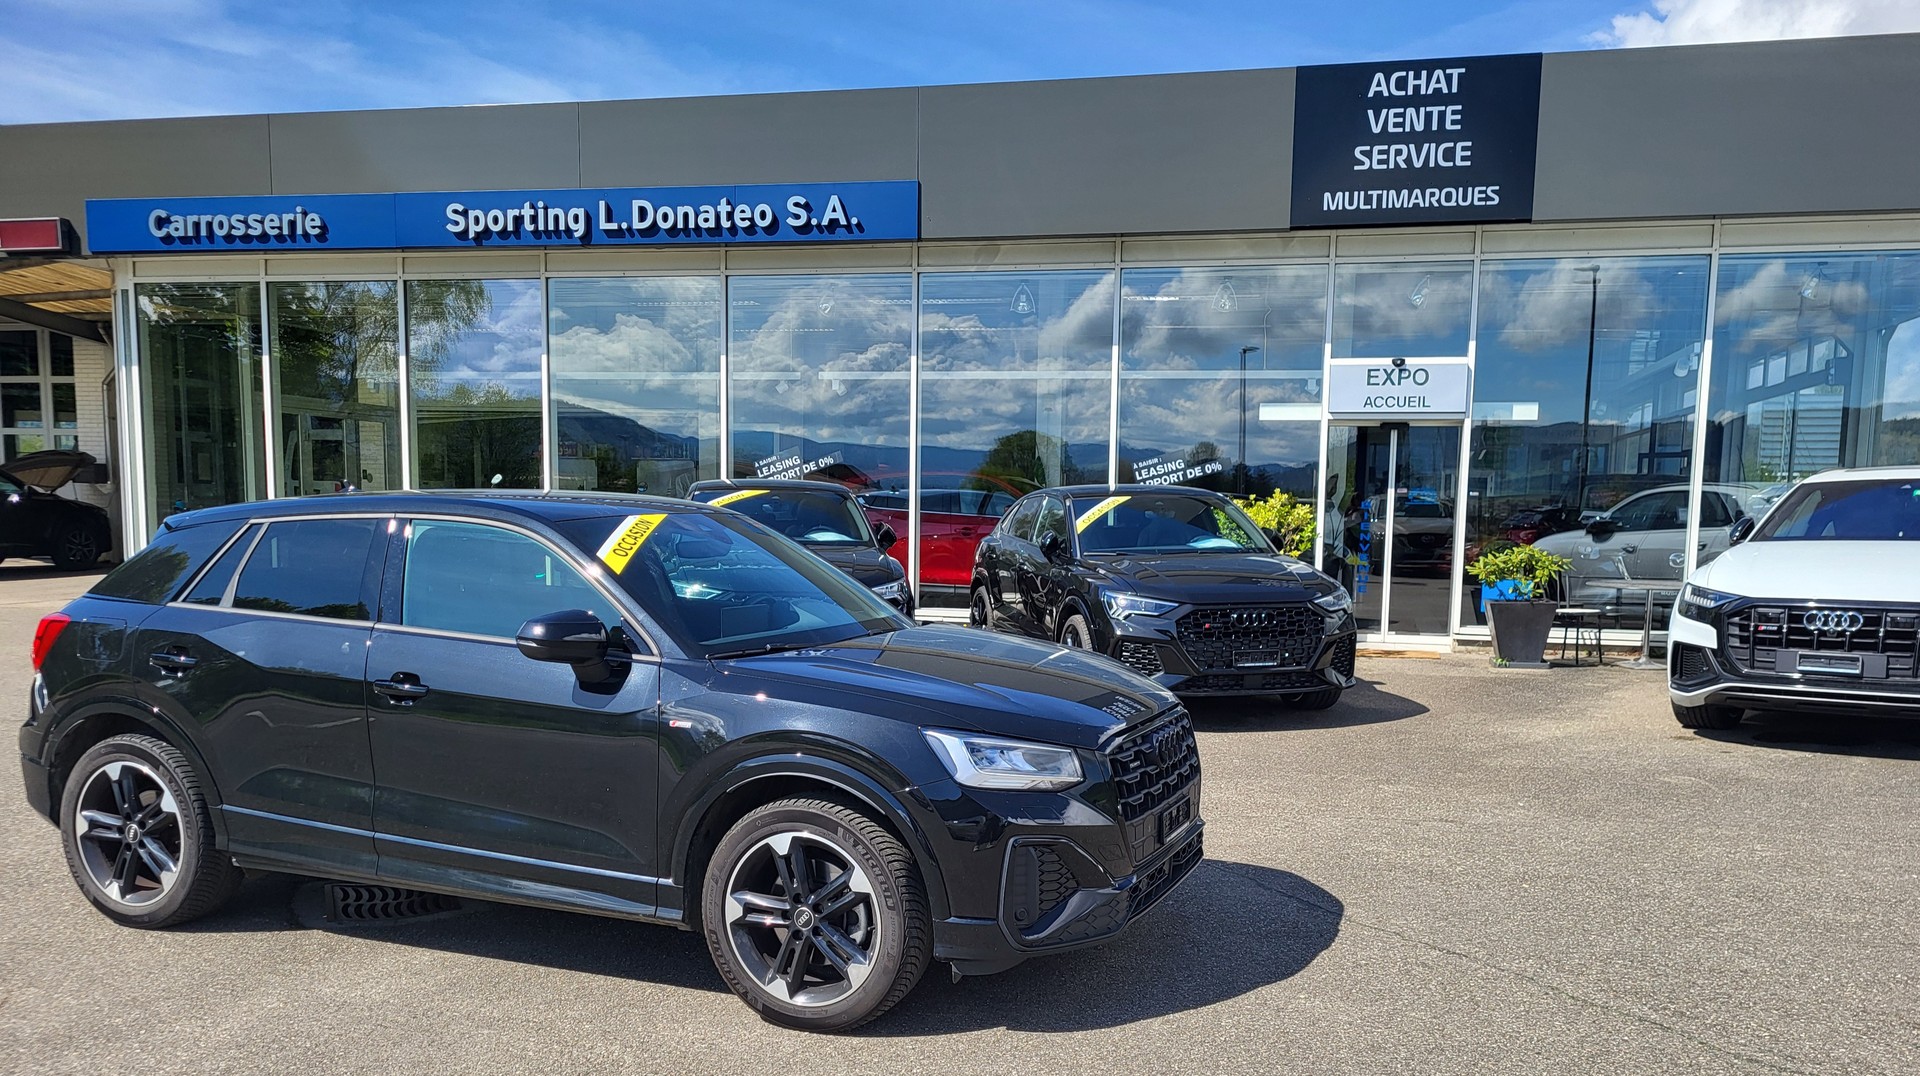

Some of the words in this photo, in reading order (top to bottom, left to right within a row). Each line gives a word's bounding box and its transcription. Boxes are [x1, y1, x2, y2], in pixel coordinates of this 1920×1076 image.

[1367, 68, 1466, 97] ACHAT
[1367, 105, 1462, 133] VENTE
[1353, 141, 1472, 170] SERVICE
[1323, 185, 1500, 211] MULTIMARQUES
[148, 206, 321, 237] Carrosserie
[445, 201, 586, 238] Sporting
[598, 197, 773, 230] L.Donateo
[785, 195, 859, 226] S.A.
[1366, 368, 1430, 386] EXPO
[1363, 396, 1431, 408] ACCUEIL
[757, 456, 800, 477] LEASING
[803, 461, 817, 473] DE
[819, 456, 834, 467] 0%
[1135, 459, 1185, 480] LEASING
[1186, 467, 1203, 479] DE
[1205, 462, 1222, 474] 0%
[1082, 499, 1120, 524] OCCASION
[612, 517, 655, 557] OCCASION
[855, 844, 894, 907] MICHELIN
[710, 932, 746, 994] MICHELIN
